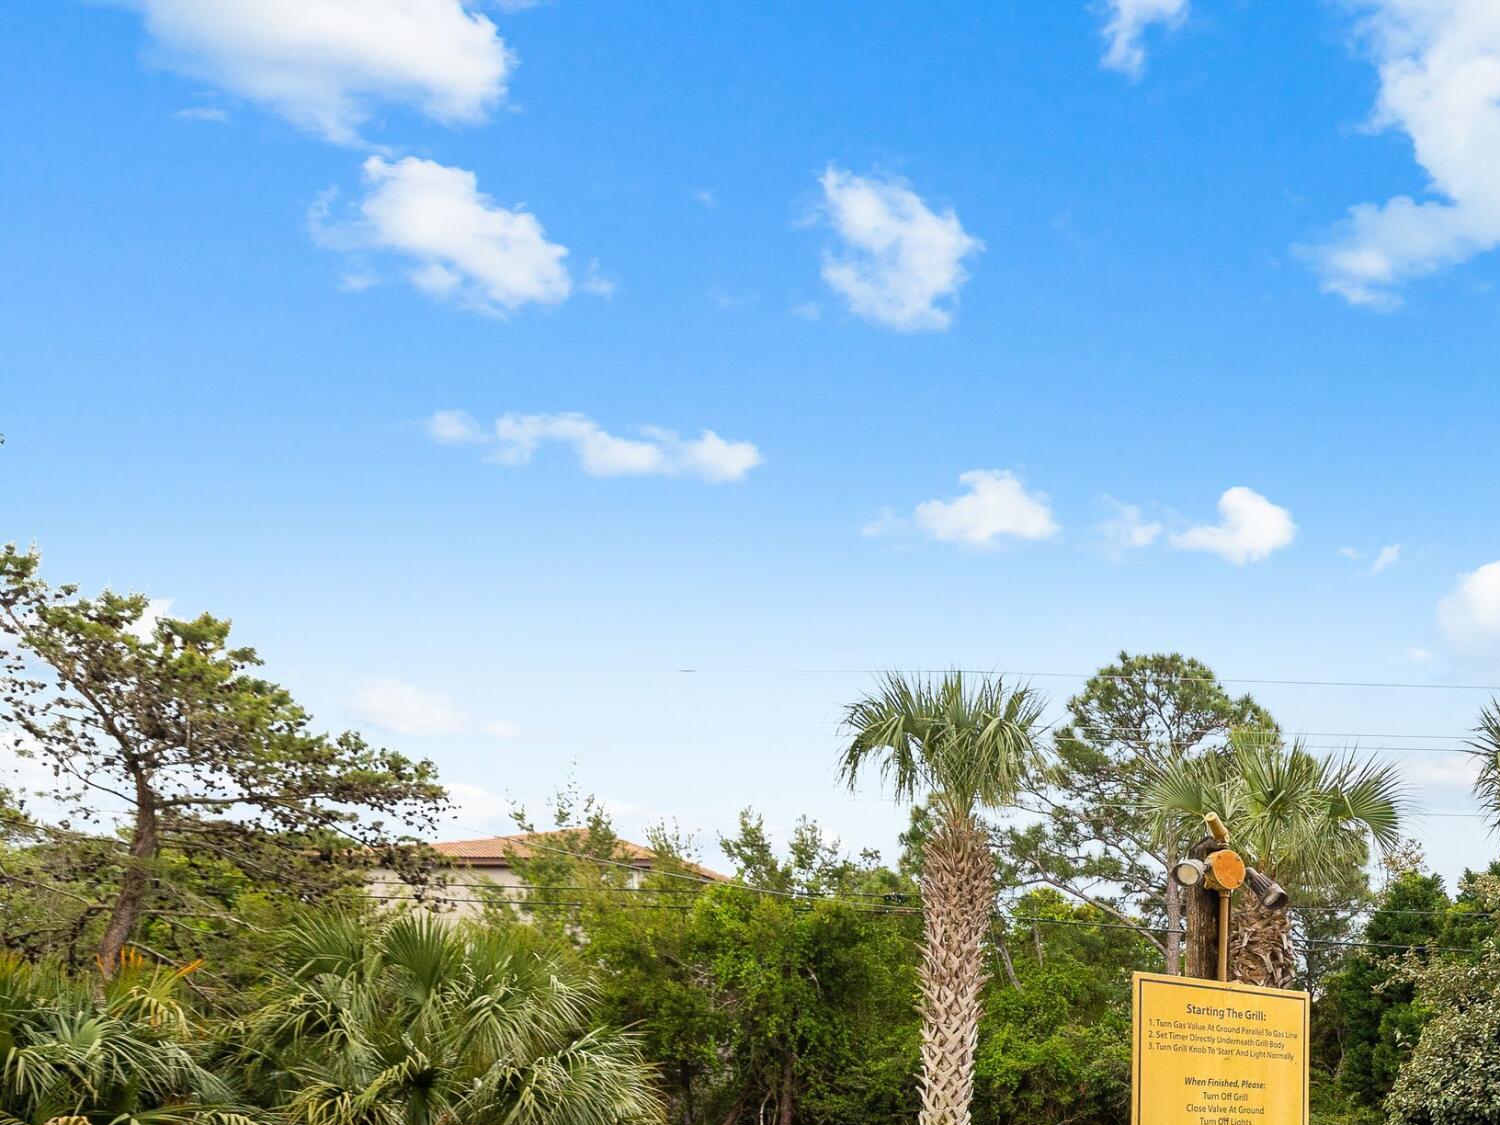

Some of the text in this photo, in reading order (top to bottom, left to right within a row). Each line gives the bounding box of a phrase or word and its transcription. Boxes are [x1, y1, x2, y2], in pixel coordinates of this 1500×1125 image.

[1186, 1003, 1267, 1022] Starting The Grill:
[1149, 1018, 1155, 1026] 1.
[1156, 1018, 1172, 1026] Turn
[1173, 1020, 1186, 1029] Gas
[1207, 1023, 1215, 1032] At
[1215, 1024, 1241, 1034] Ground
[1241, 1026, 1265, 1037] Parallel
[1265, 1029, 1273, 1037] To
[1273, 1029, 1285, 1039] Gas
[1285, 1031, 1299, 1039] Line
[1148, 1030, 1285, 1050] 2. Set Timer Directly Underneath Grill Body
[1148, 1042, 1155, 1050] 3.
[1156, 1042, 1172, 1051] Turn
[1173, 1043, 1187, 1052] Grill
[1188, 1045, 1207, 1054] Knob
[1208, 1046, 1216, 1055] To
[1235, 1048, 1249, 1057] And
[1249, 1050, 1266, 1059] Light
[1266, 1051, 1295, 1062] Normally
[1184, 1077, 1266, 1089] When Finished, Please:
[1203, 1091, 1249, 1102] Turn Off Grill
[1186, 1103, 1265, 1115] Close Valve At Ground
[1200, 1117, 1217, 1125] Turn
